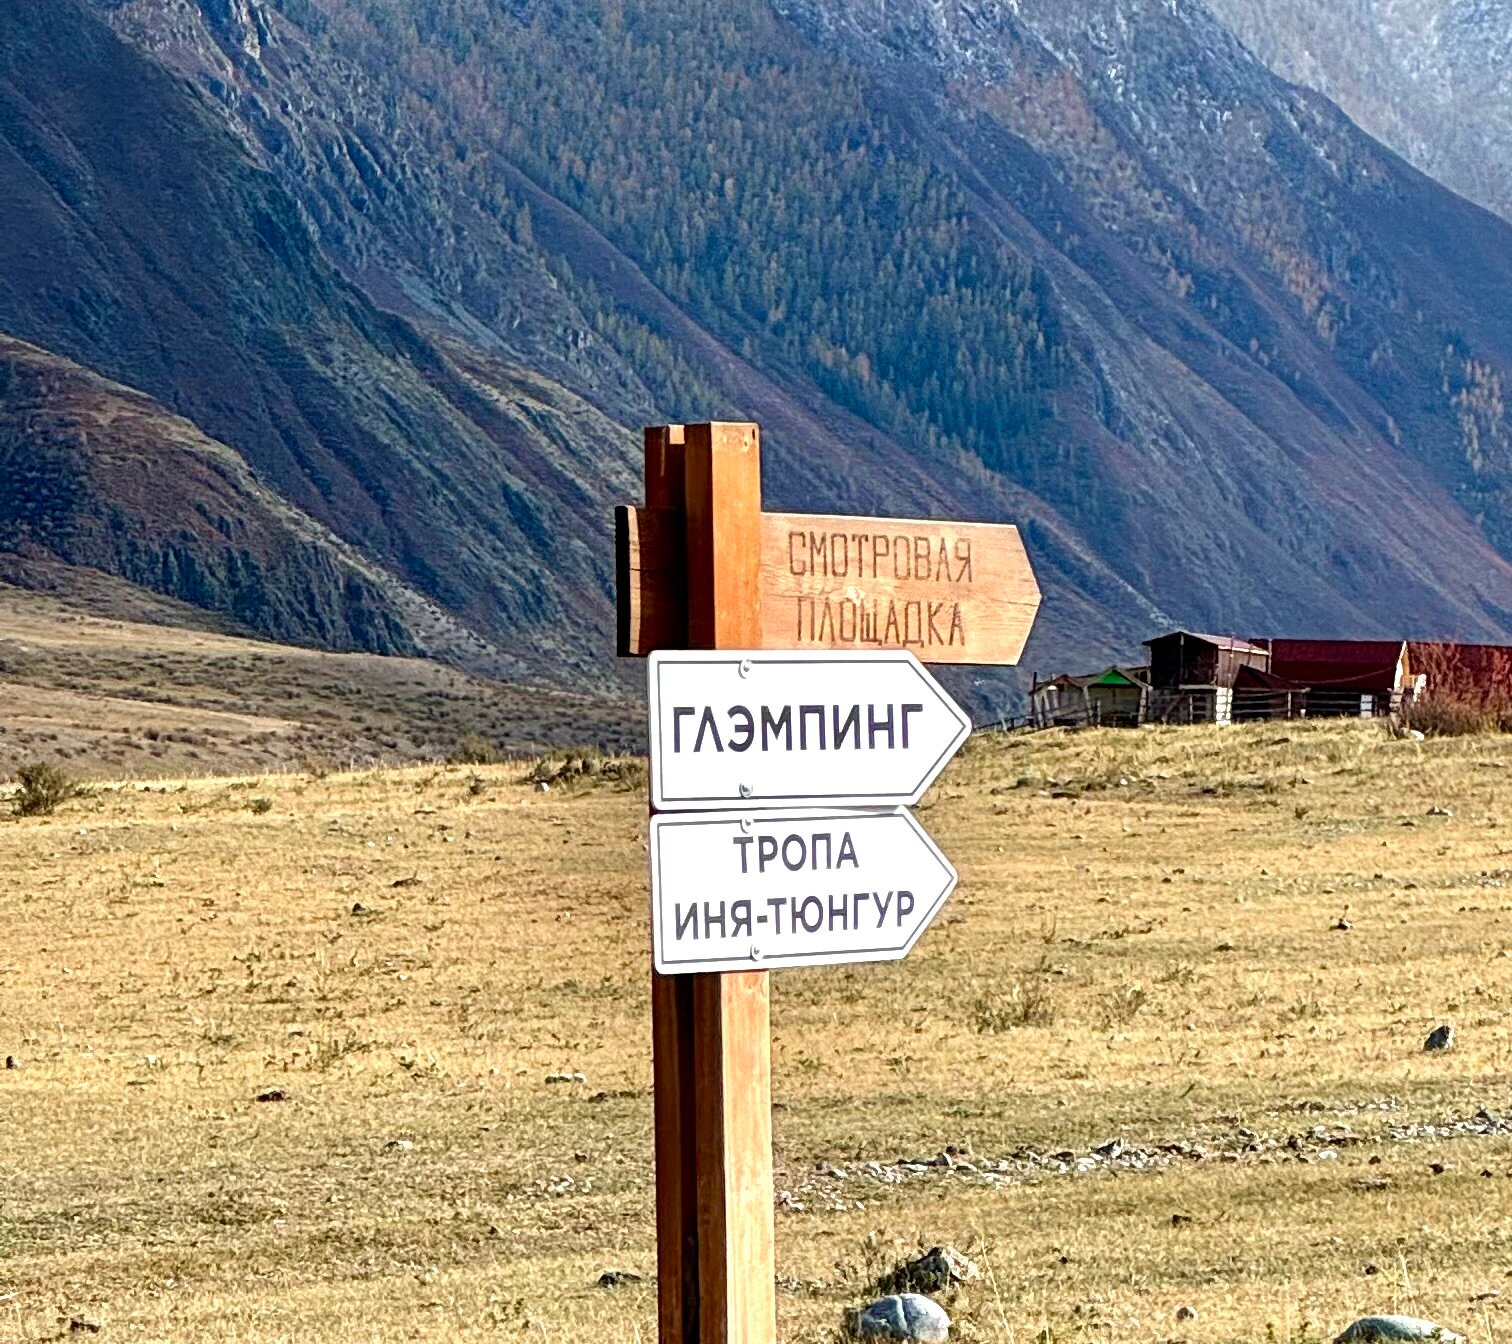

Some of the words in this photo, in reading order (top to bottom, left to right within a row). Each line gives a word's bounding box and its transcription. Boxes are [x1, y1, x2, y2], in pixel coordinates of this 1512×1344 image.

[788, 530, 973, 583] СМОТРОВАЯ
[796, 595, 966, 648] ПЛОЩАДКА
[673, 703, 924, 753] ГЛЭМПИНГ
[733, 831, 860, 875] ТРОПА
[675, 890, 916, 941] ИНЯ-ТЮНГУР
